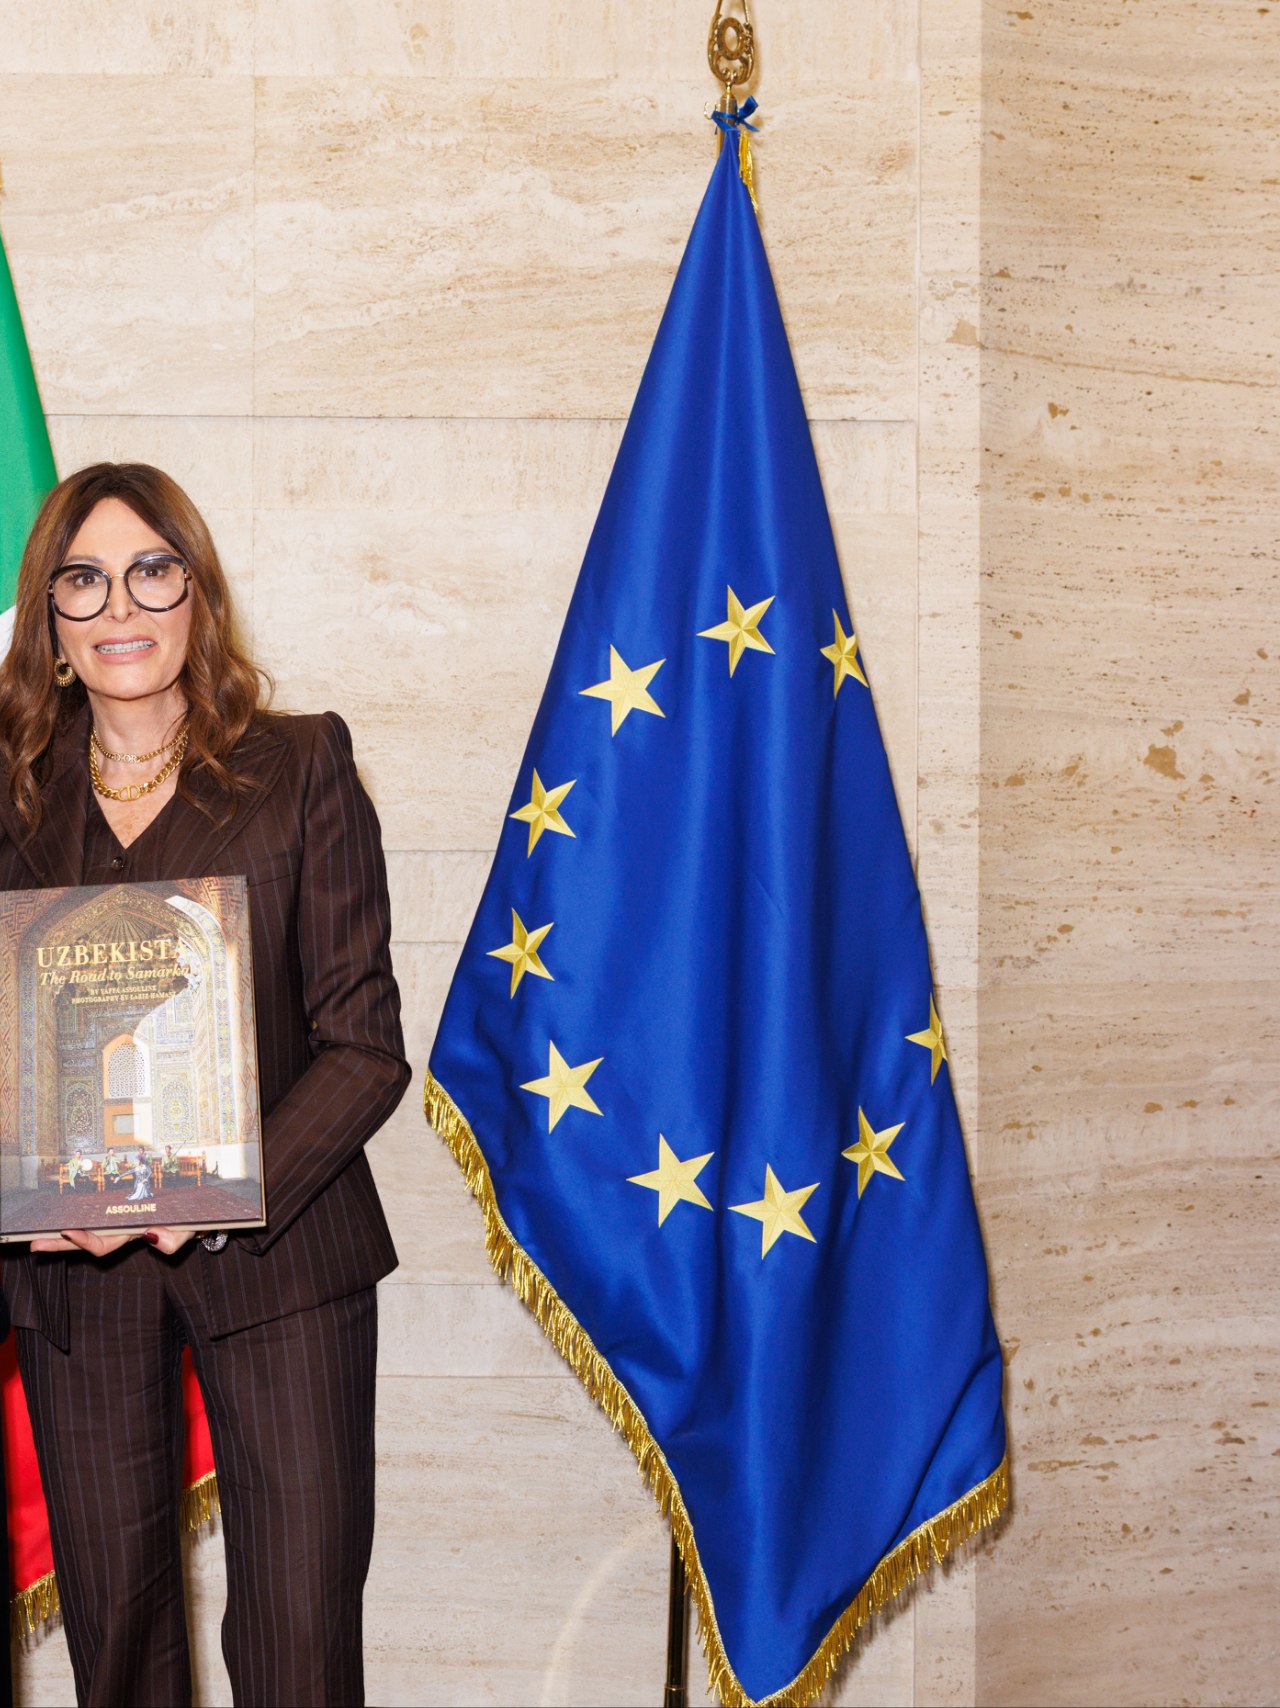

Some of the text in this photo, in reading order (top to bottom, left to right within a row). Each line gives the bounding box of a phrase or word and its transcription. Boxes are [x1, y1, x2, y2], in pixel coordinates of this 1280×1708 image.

[40, 962, 196, 986] The Road to Samarka
[90, 988, 100, 996] BY
[122, 985, 157, 993] ASSOULINE
[71, 994, 119, 1004] PHOTOGRAPHY
[120, 993, 129, 1001] BY
[105, 1203, 157, 1215] ASSOULINE
